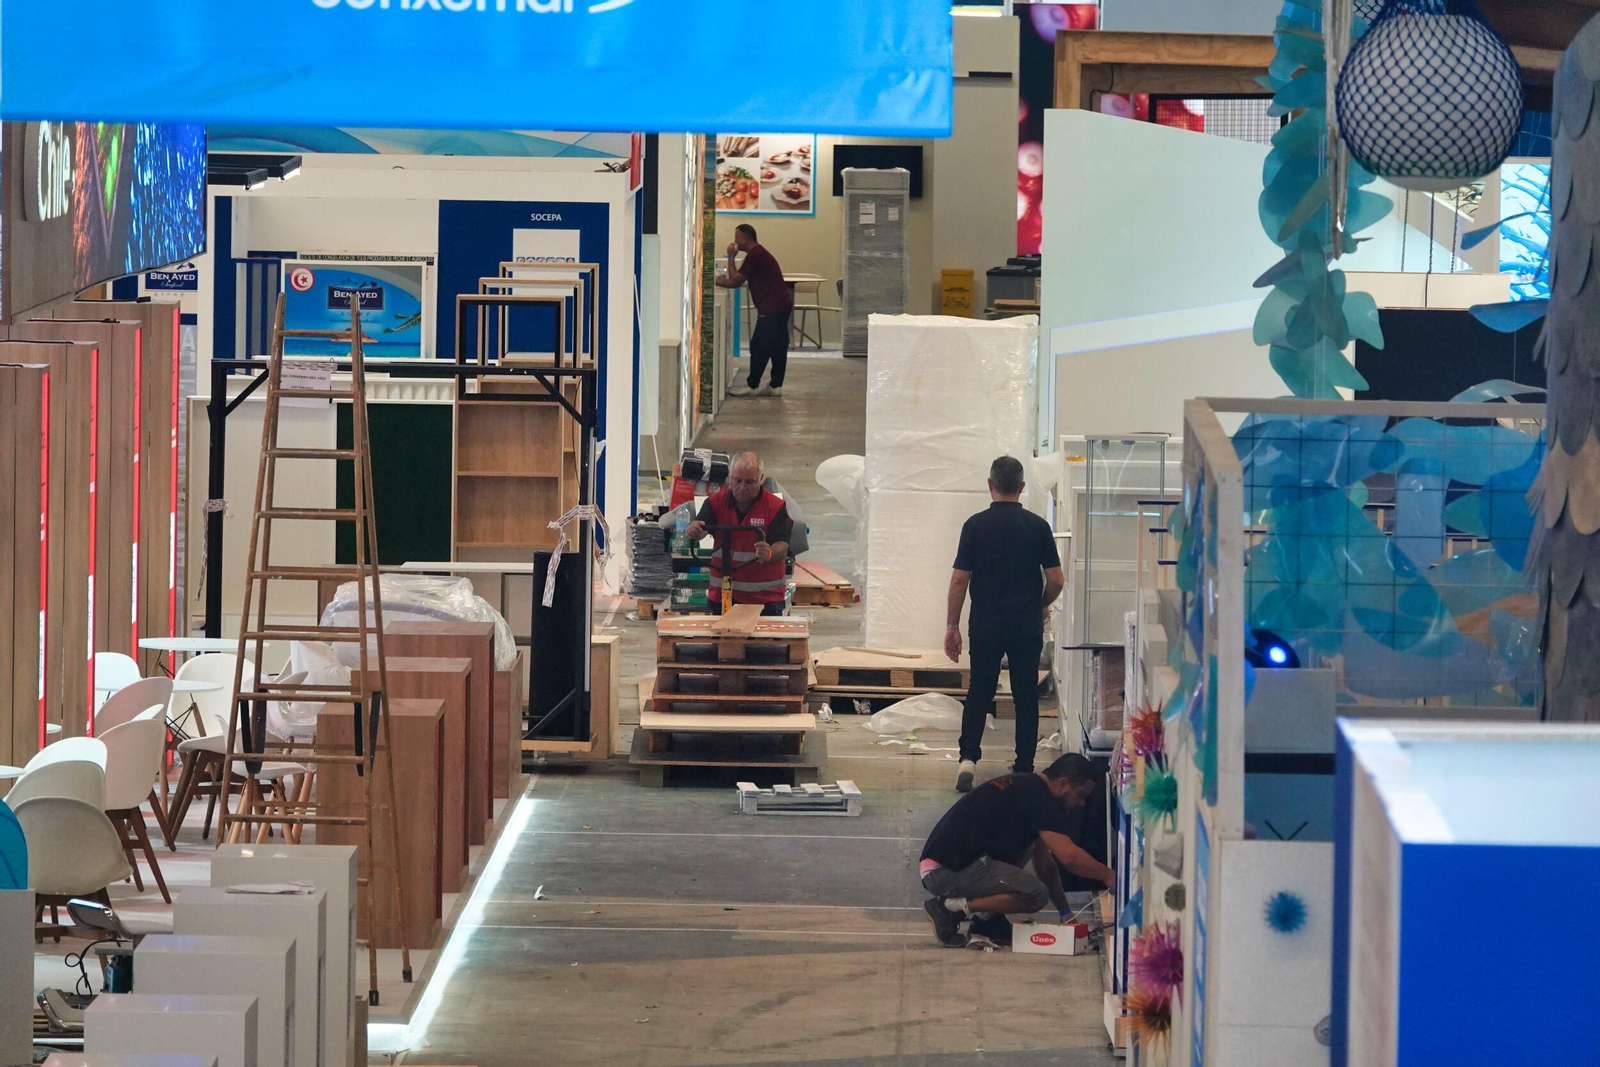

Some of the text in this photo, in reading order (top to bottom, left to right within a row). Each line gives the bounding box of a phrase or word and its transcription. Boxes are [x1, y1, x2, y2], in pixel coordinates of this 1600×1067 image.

[38, 120, 70, 221] Chile
[530, 213, 562, 221] SOCEPA
[150, 272, 170, 280] BEN
[333, 290, 352, 298] BEN
